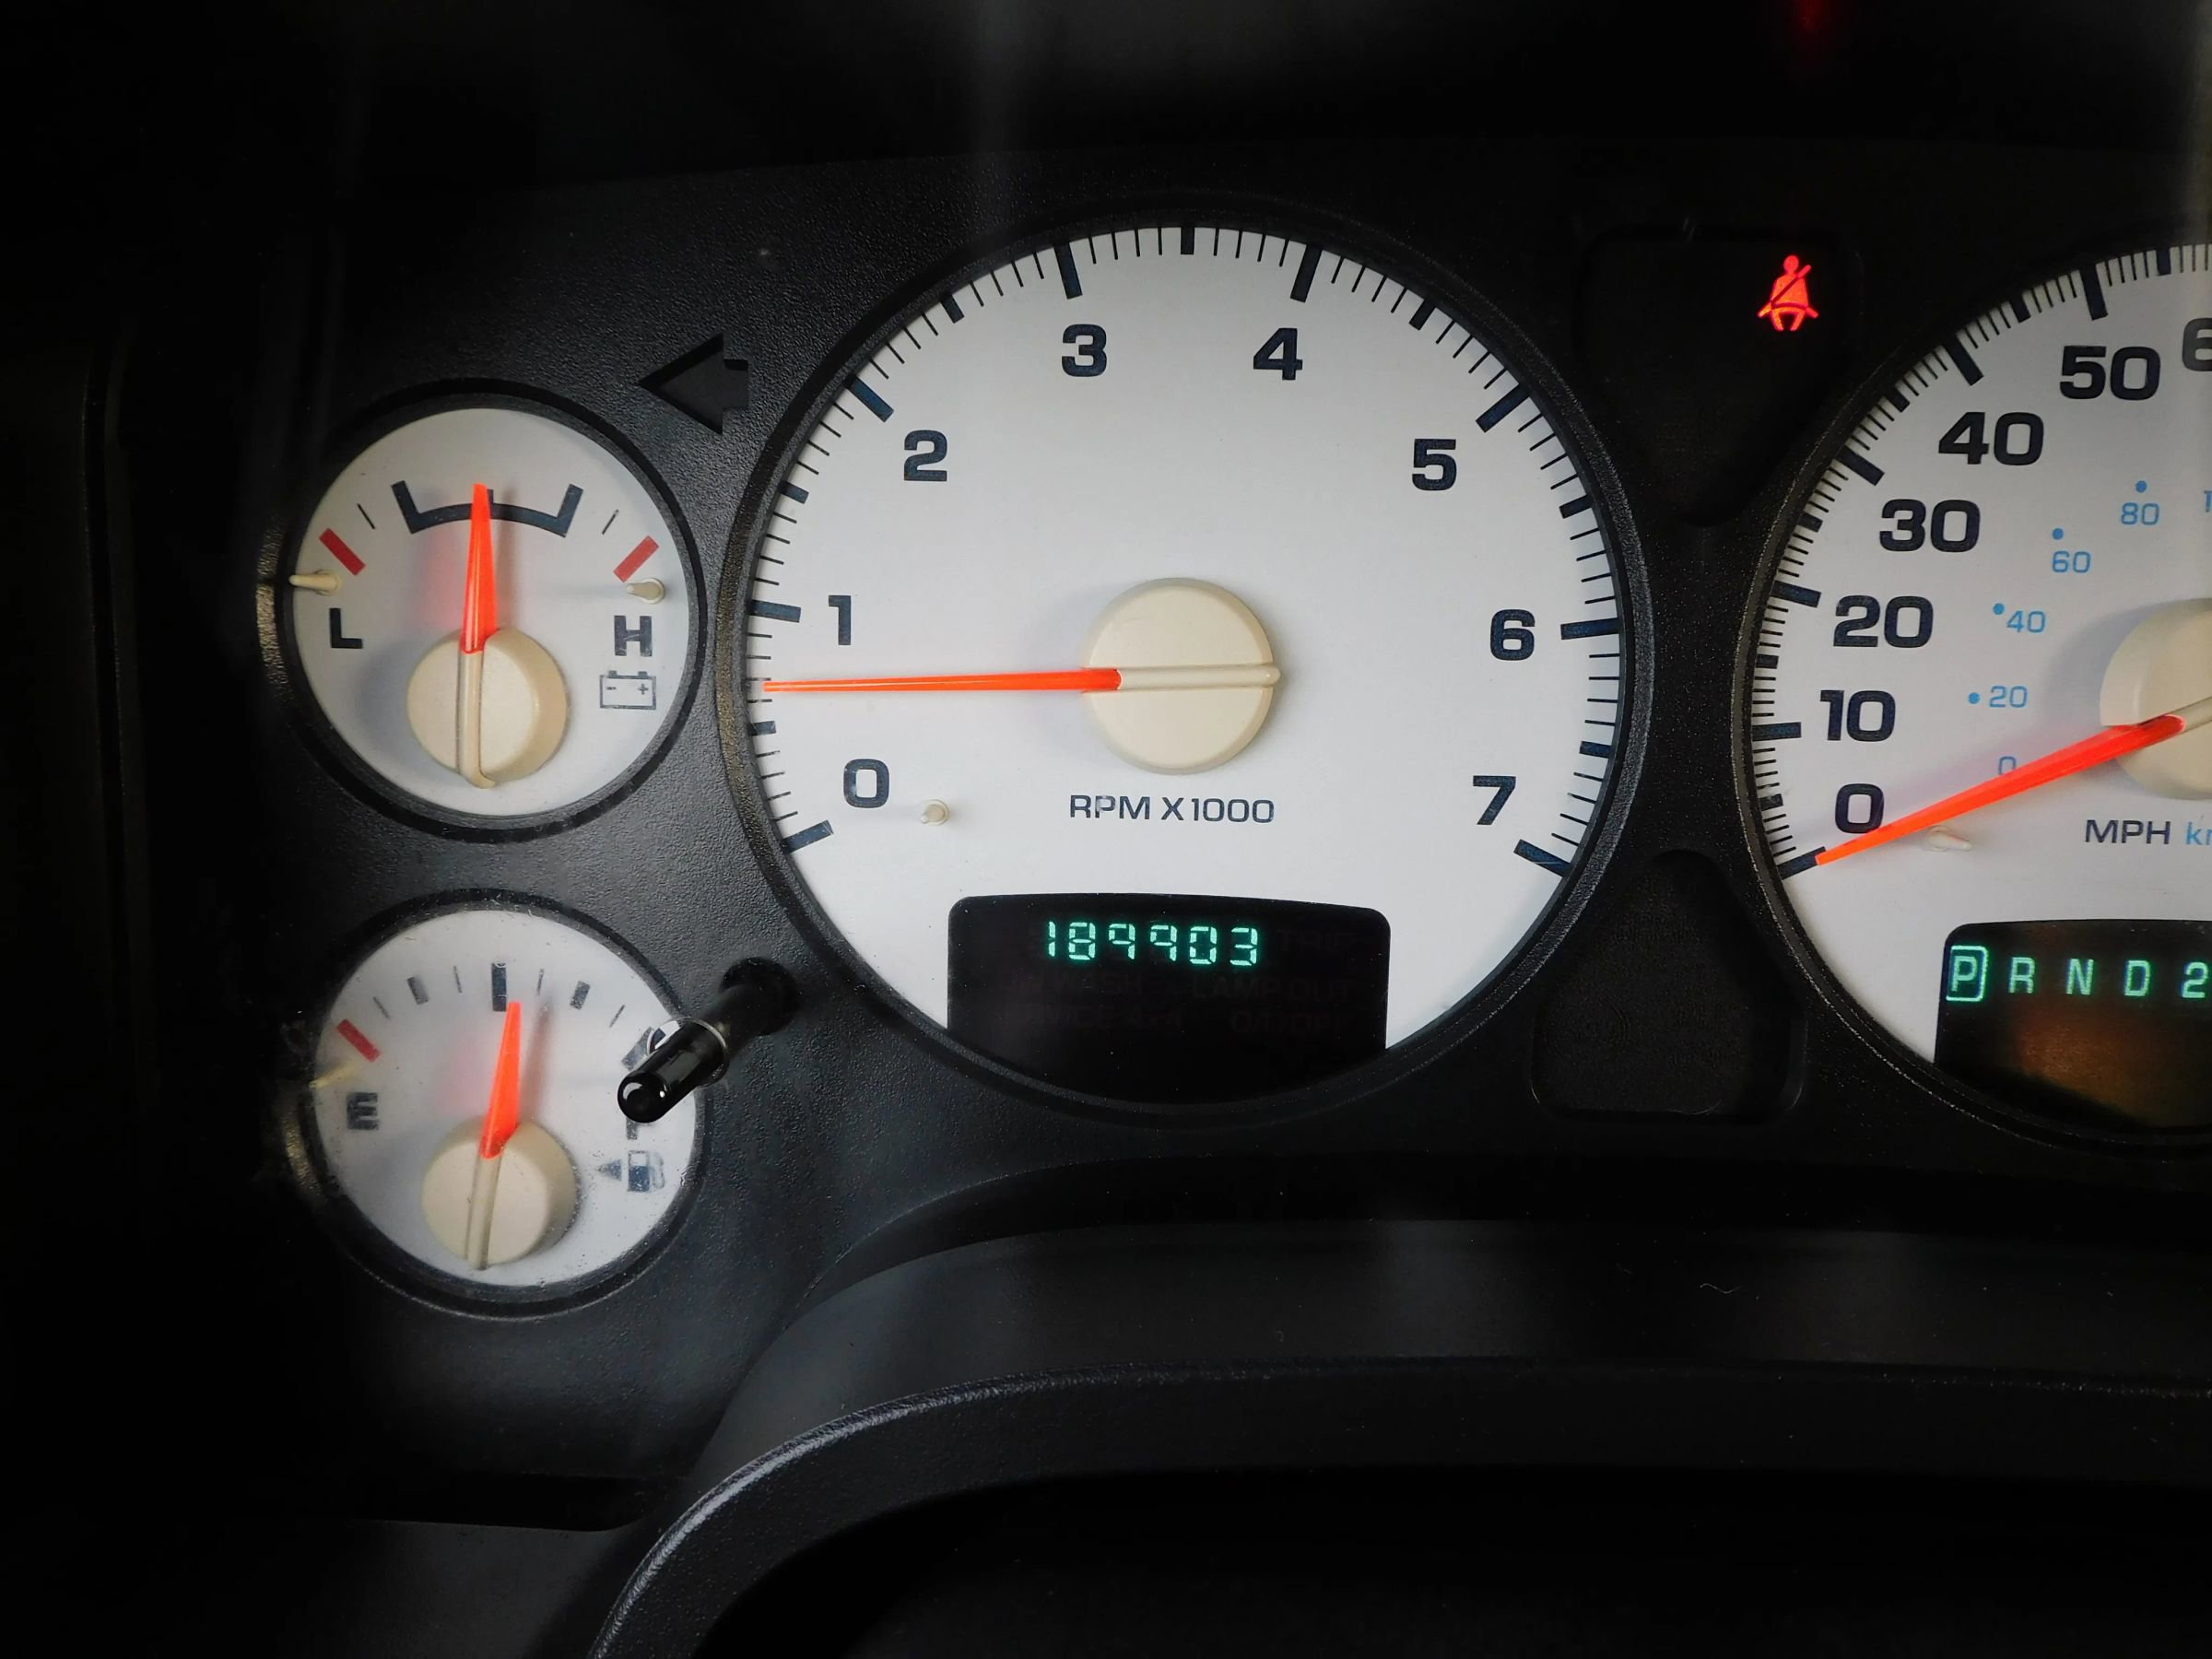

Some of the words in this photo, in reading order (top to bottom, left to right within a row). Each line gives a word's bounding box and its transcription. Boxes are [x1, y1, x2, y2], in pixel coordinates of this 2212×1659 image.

[1061, 324, 1108, 378] 3
[1253, 327, 1303, 381] 4
[2060, 345, 2160, 400] 50
[903, 429, 948, 482] 2
[1938, 411, 2044, 465] 40
[1411, 438, 1457, 491] 5
[1879, 499, 1981, 553] 30
[2120, 501, 2160, 525] 80
[2052, 550, 2092, 574] 60
[328, 607, 363, 650] L
[613, 615, 653, 657] H
[828, 594, 852, 646] 1
[1489, 608, 1535, 662] 6
[1833, 595, 1934, 648] 20
[2006, 610, 2047, 634] 40
[1819, 689, 1896, 742] 10
[1989, 685, 2029, 708] 20
[842, 758, 890, 809] 0
[1069, 794, 1151, 820] RPM
[1191, 797, 1275, 824] 1000
[1472, 775, 1517, 826] 7
[1834, 783, 1885, 834] 0
[2085, 819, 2171, 845] MPH
[1048, 921, 1258, 967] 189903
[1951, 955, 1979, 992] P
[2008, 956, 2036, 994] R
[2065, 958, 2095, 995] N
[2124, 959, 2151, 997] D
[2181, 961, 2209, 999] 2
[347, 1091, 379, 1131] E
